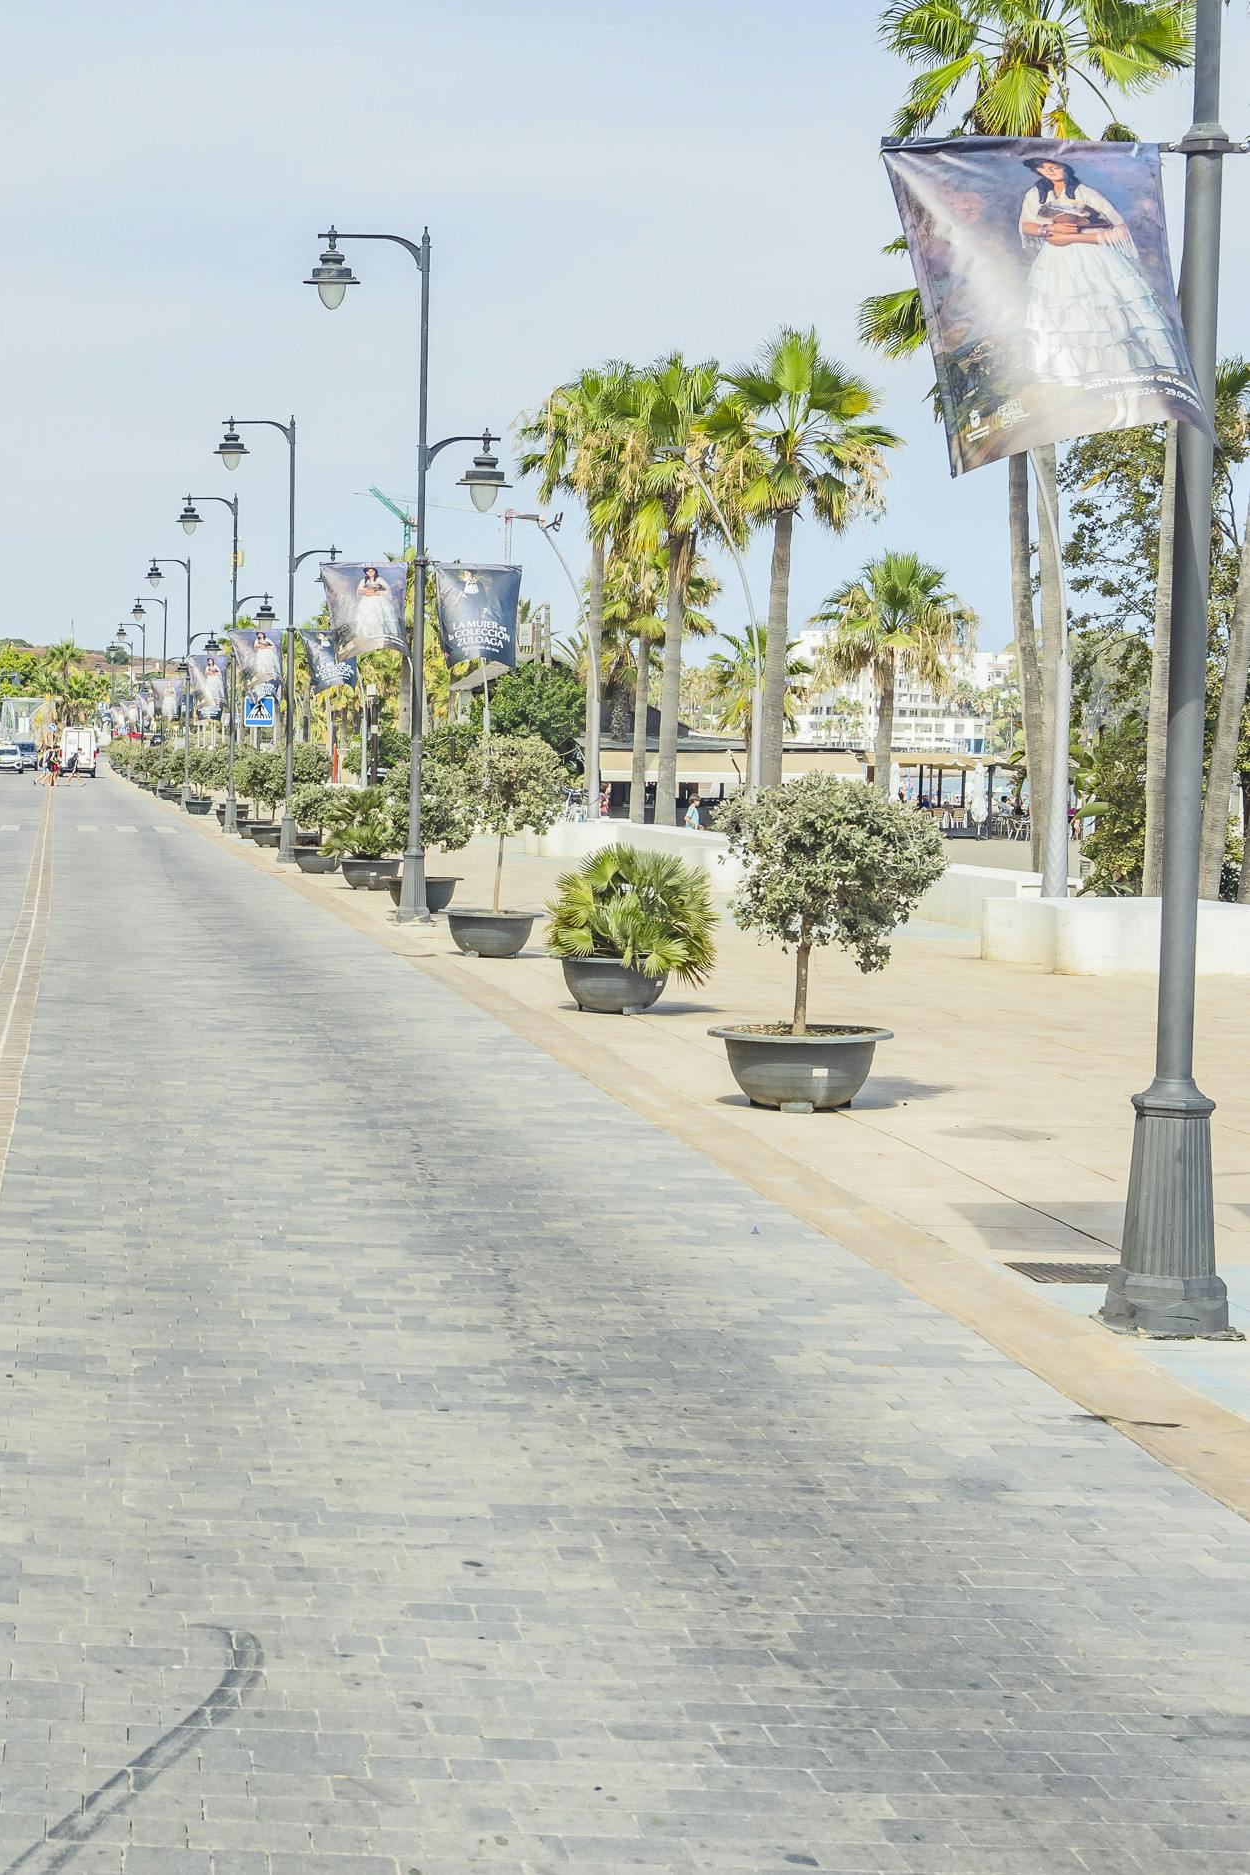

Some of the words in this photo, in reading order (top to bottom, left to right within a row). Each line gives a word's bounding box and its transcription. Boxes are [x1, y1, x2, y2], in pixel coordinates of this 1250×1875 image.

[1084, 379, 1109, 390] Sala
[1156, 374, 1173, 383] del
[452, 622, 465, 630] LA
[467, 620, 498, 630] MUJER
[456, 636, 504, 649] ZULOAGA
